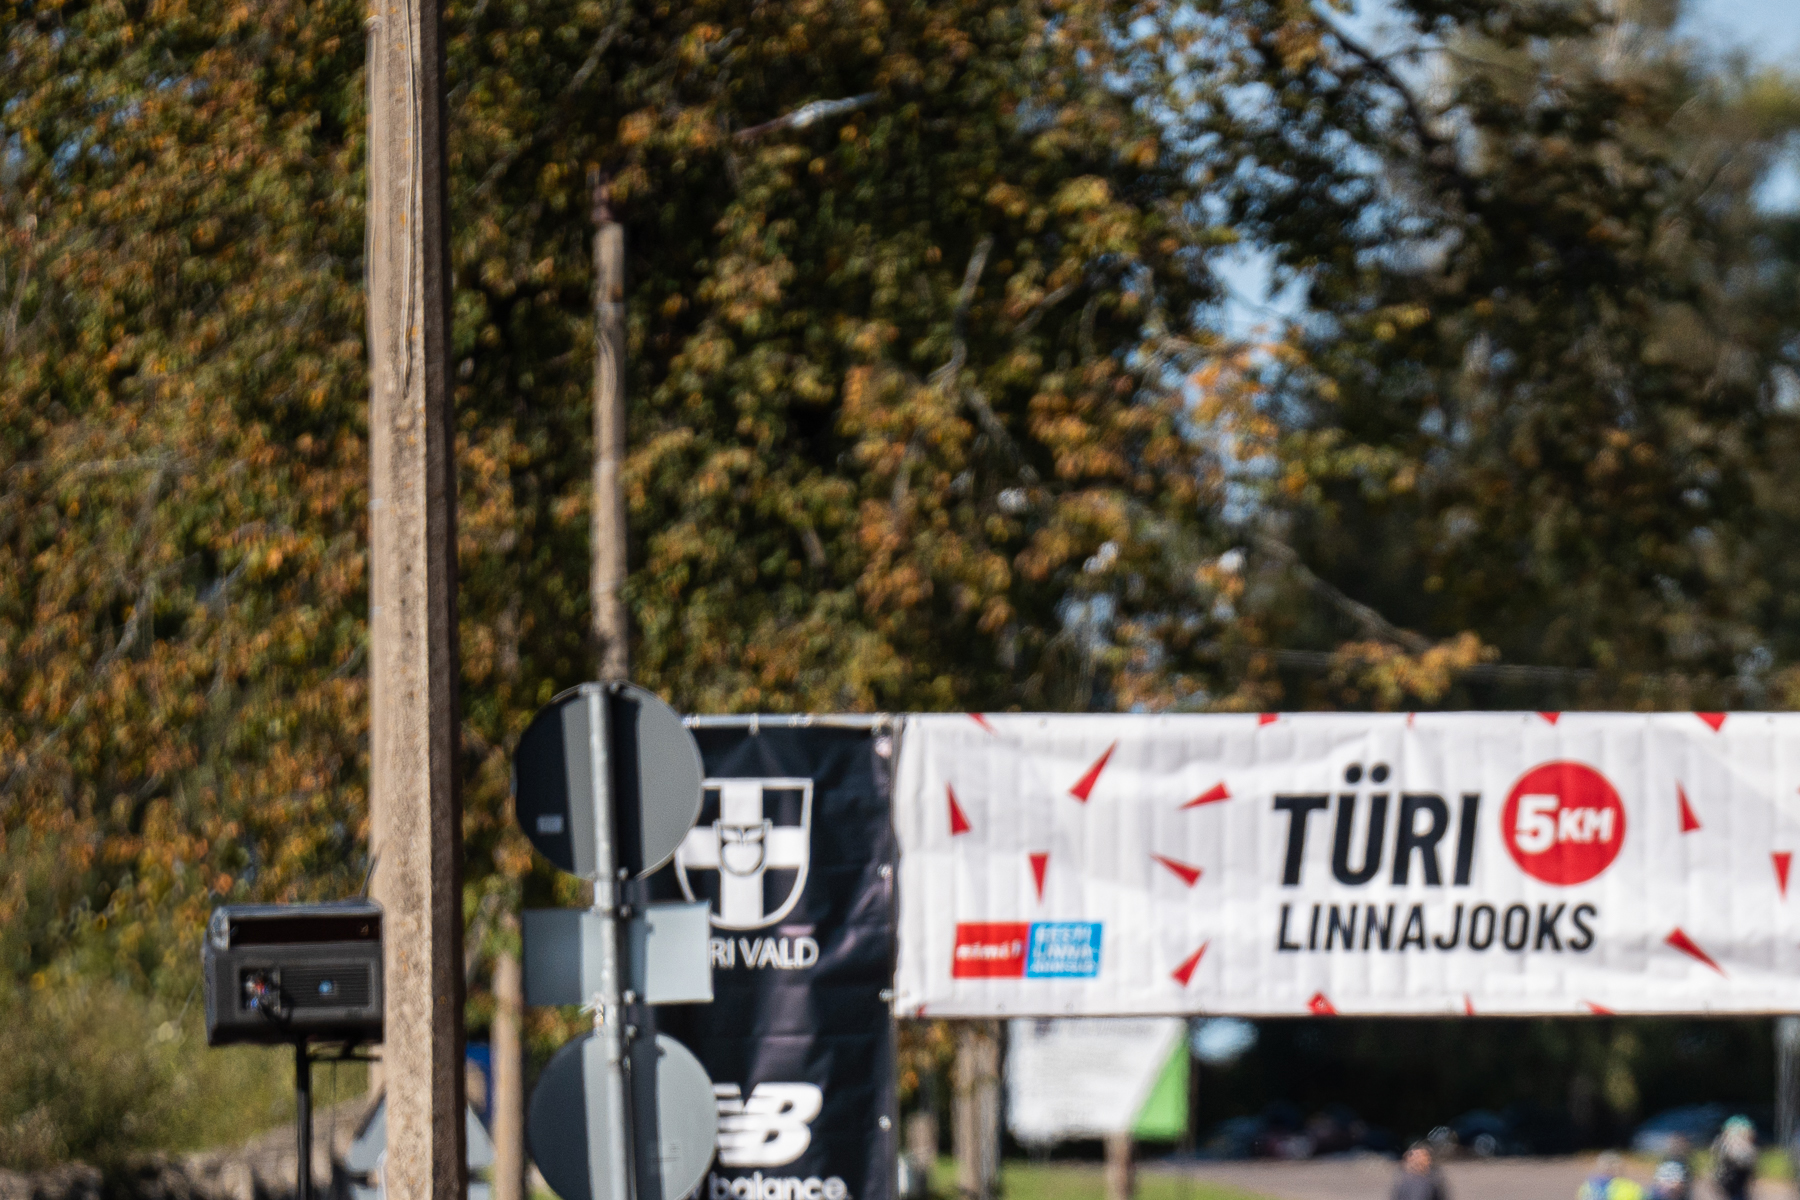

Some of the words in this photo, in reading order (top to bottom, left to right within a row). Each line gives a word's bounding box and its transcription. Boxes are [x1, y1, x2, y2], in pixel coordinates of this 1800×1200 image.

[1273, 763, 1482, 886] TÜRI
[1514, 794, 1617, 854] 5KM
[1277, 903, 1598, 952] LINNAJOOKS
[710, 937, 735, 968] RI
[738, 937, 820, 968] VALD
